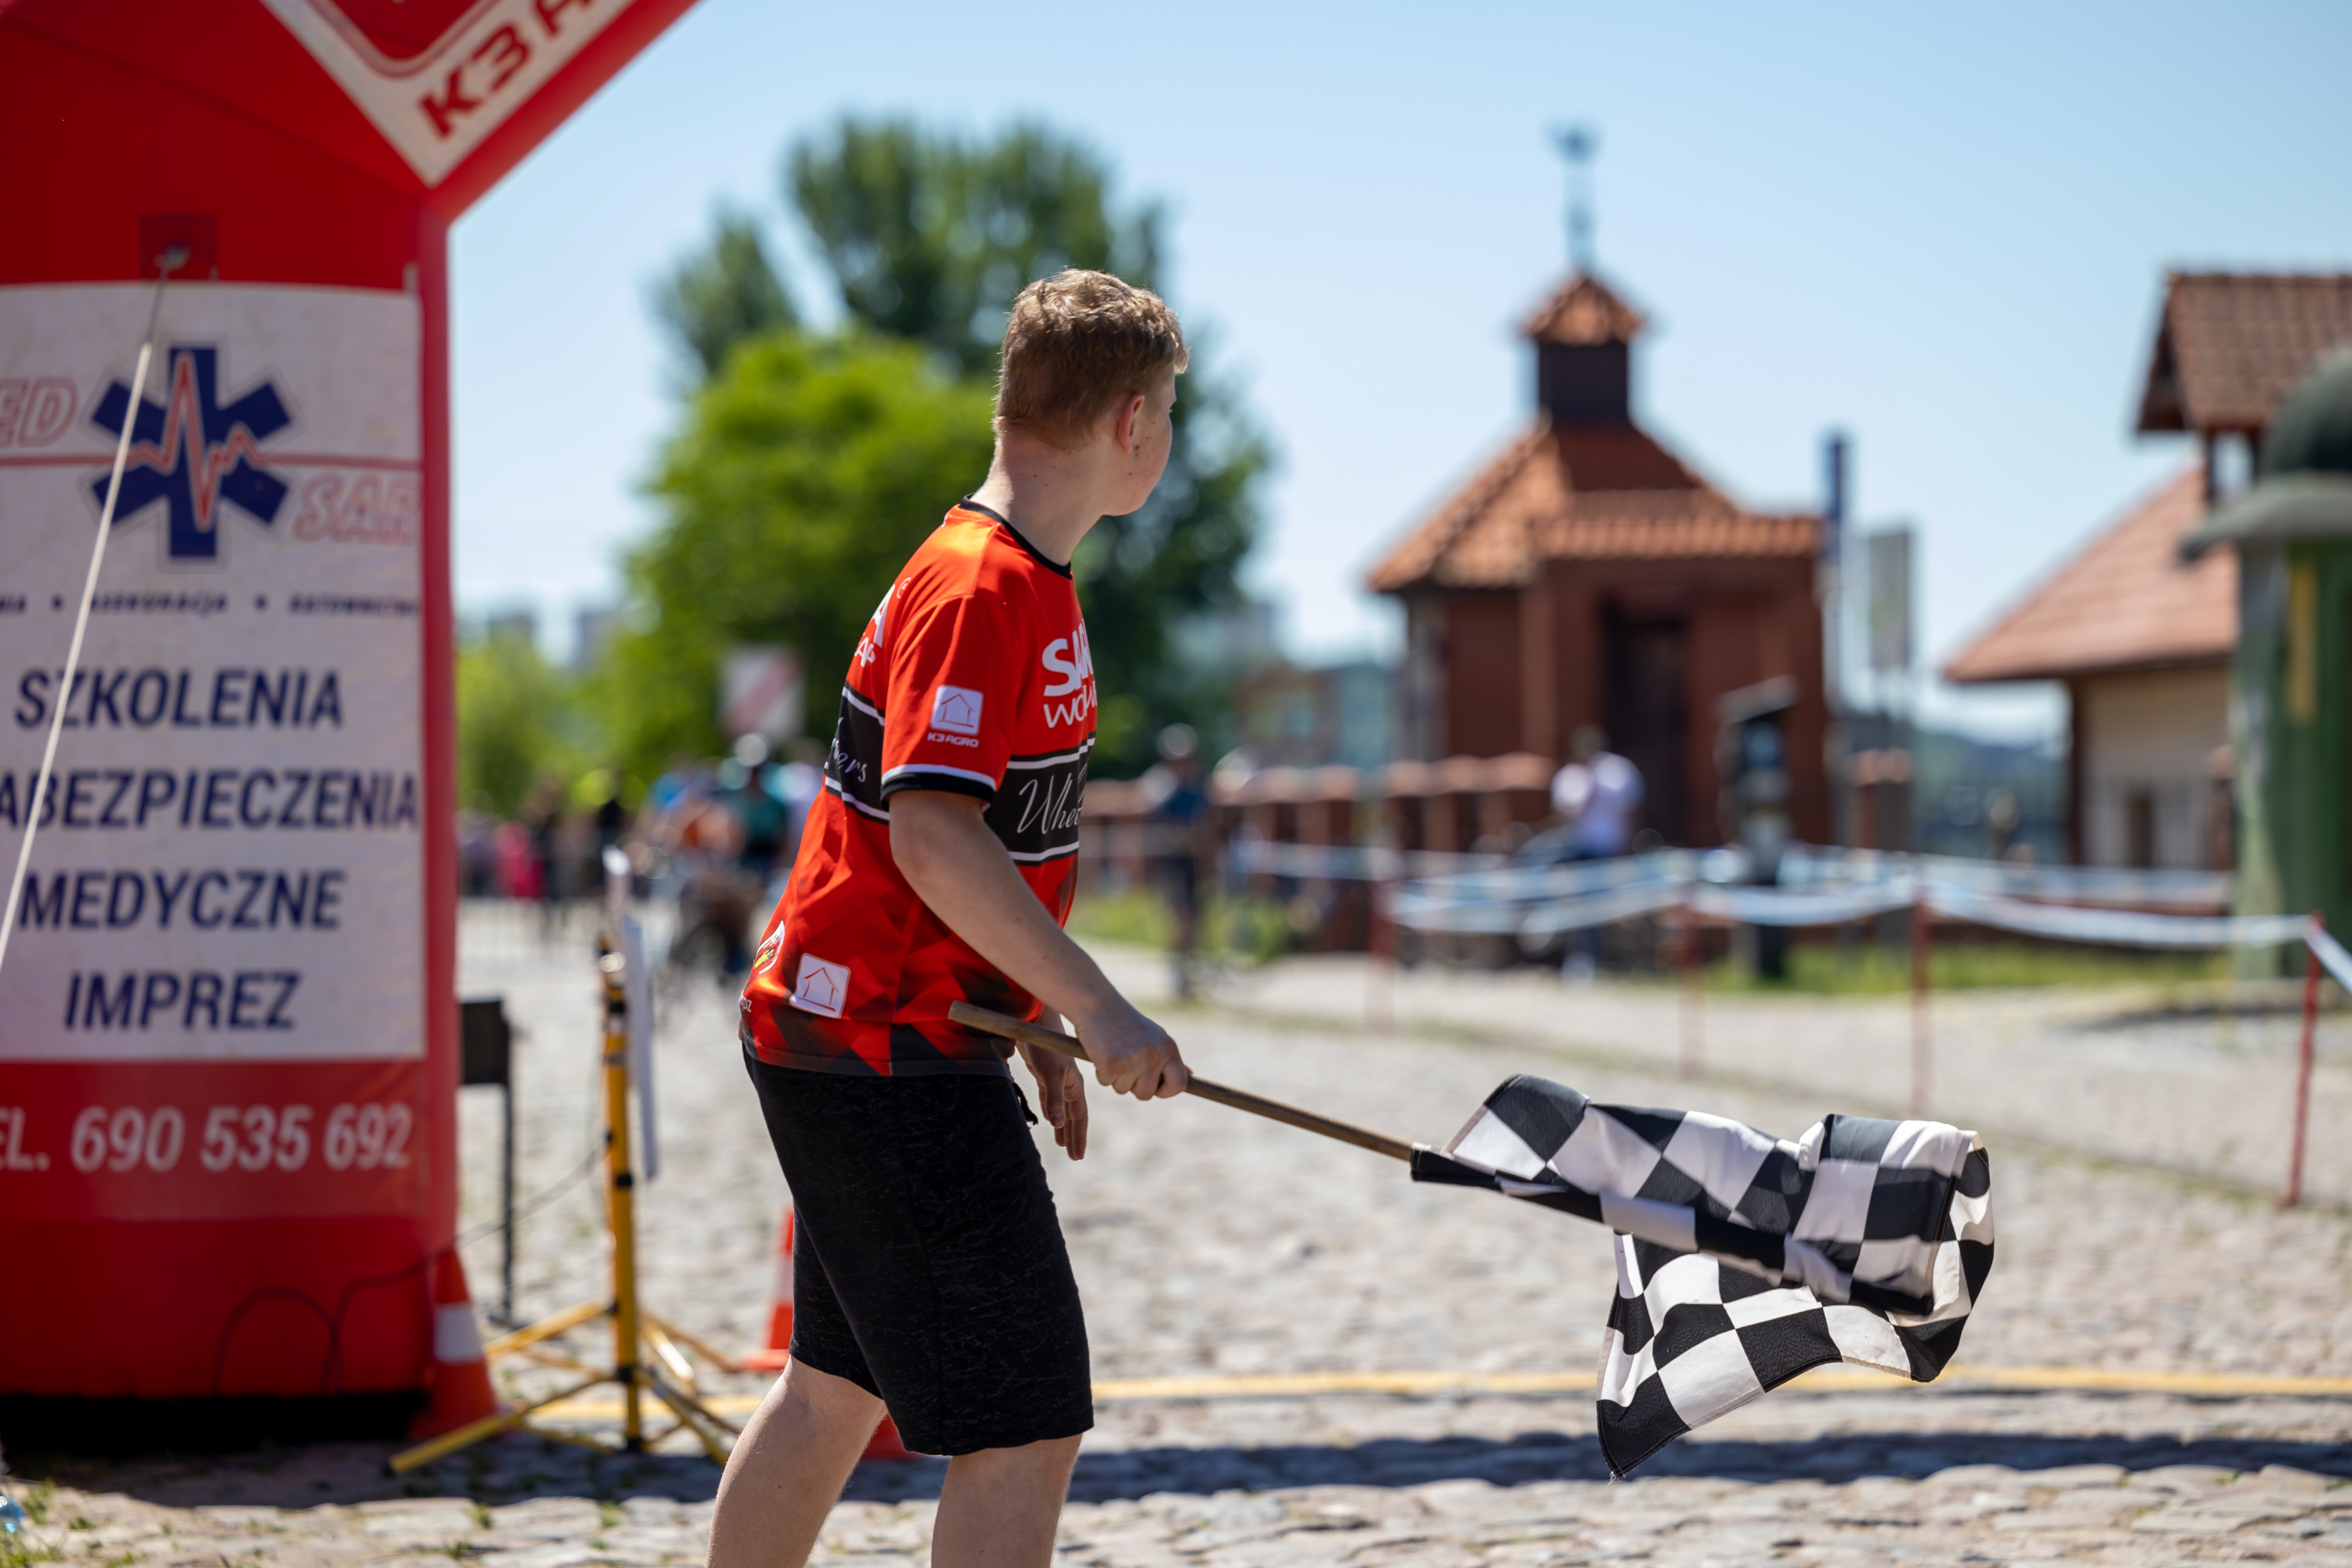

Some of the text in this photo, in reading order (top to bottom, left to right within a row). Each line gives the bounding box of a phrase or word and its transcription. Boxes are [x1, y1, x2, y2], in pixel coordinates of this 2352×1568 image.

[420, 21, 532, 139] K3
[0, 377, 79, 447] ED
[15, 667, 343, 730] SZKOLENIA
[927, 732, 979, 748] K3 AGRO
[0, 768, 419, 831] ABEZPIECZENIA
[17, 870, 346, 932] MEDYCZNE
[64, 970, 303, 1032] IMPREZ
[69, 1105, 185, 1172] 690
[199, 1103, 313, 1172] 535
[323, 1102, 412, 1171] 692
